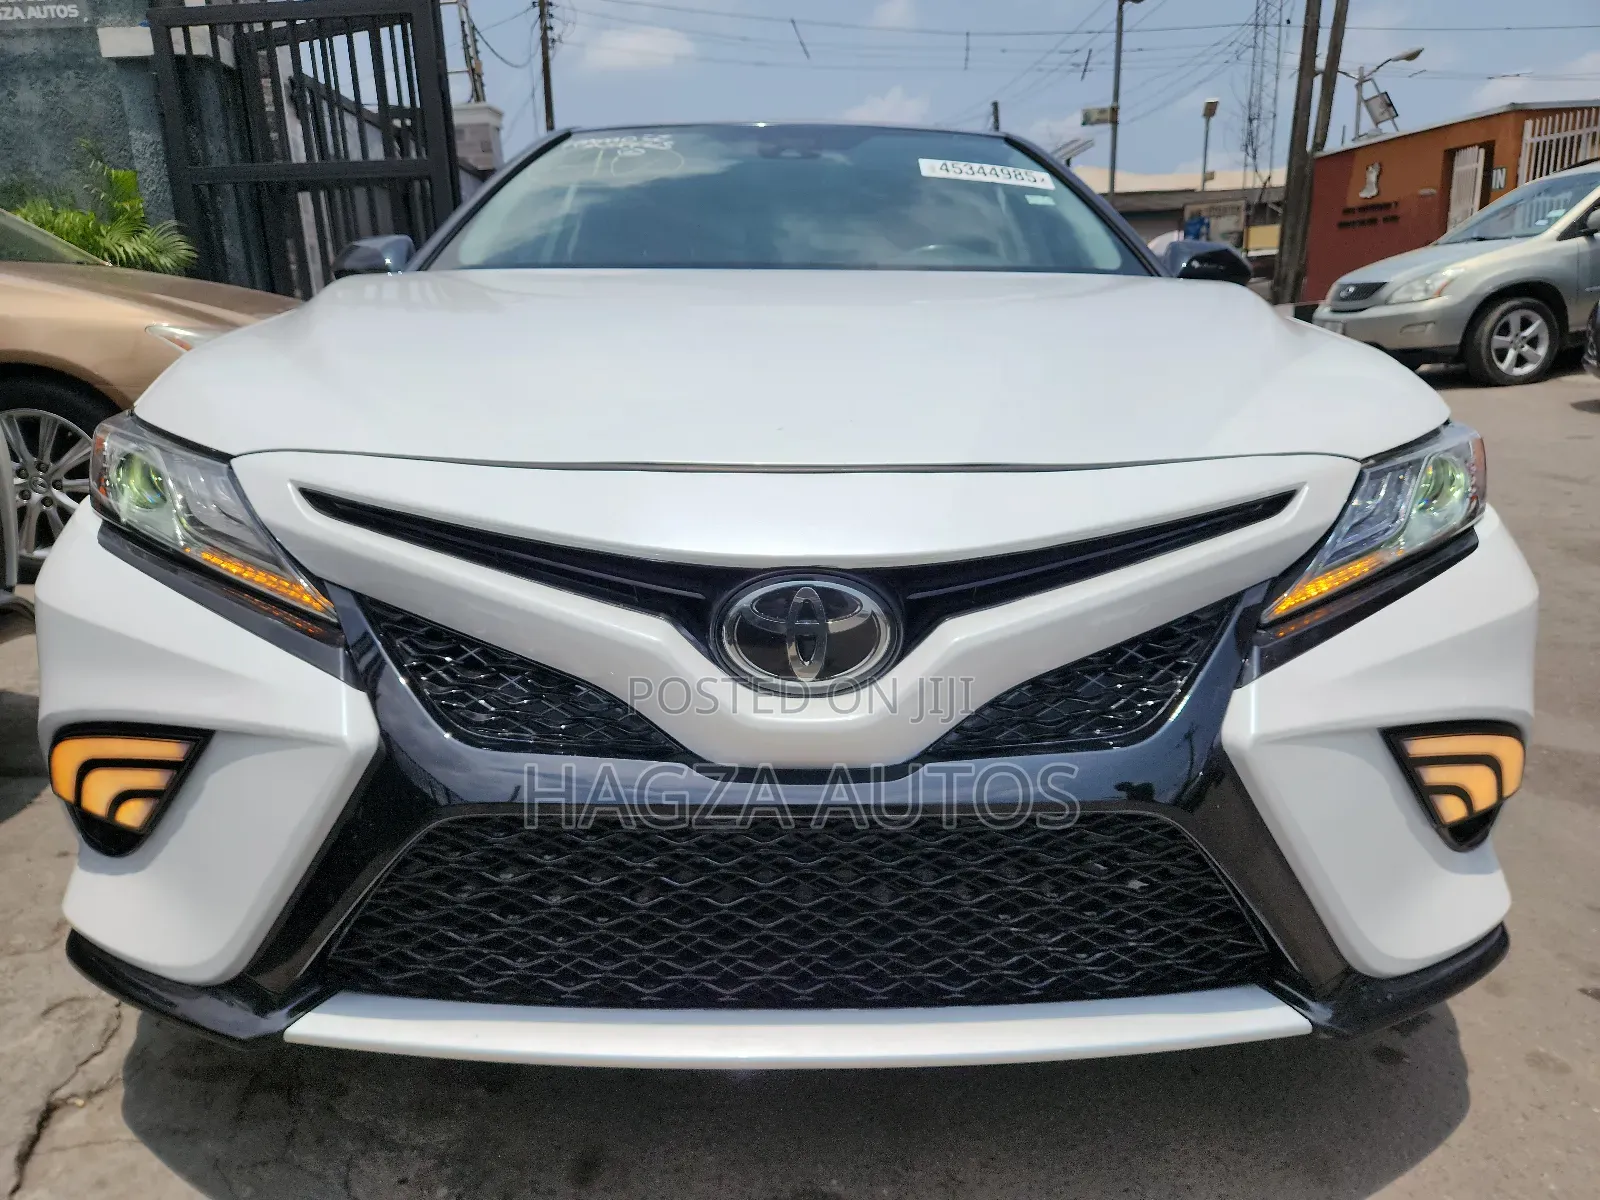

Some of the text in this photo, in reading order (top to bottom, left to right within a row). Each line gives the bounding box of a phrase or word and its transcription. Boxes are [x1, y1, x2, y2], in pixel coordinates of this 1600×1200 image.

[0, 4, 79, 20] ZA AUTOS
[940, 161, 1037, 183] 45344985
[1492, 167, 1506, 189] IN
